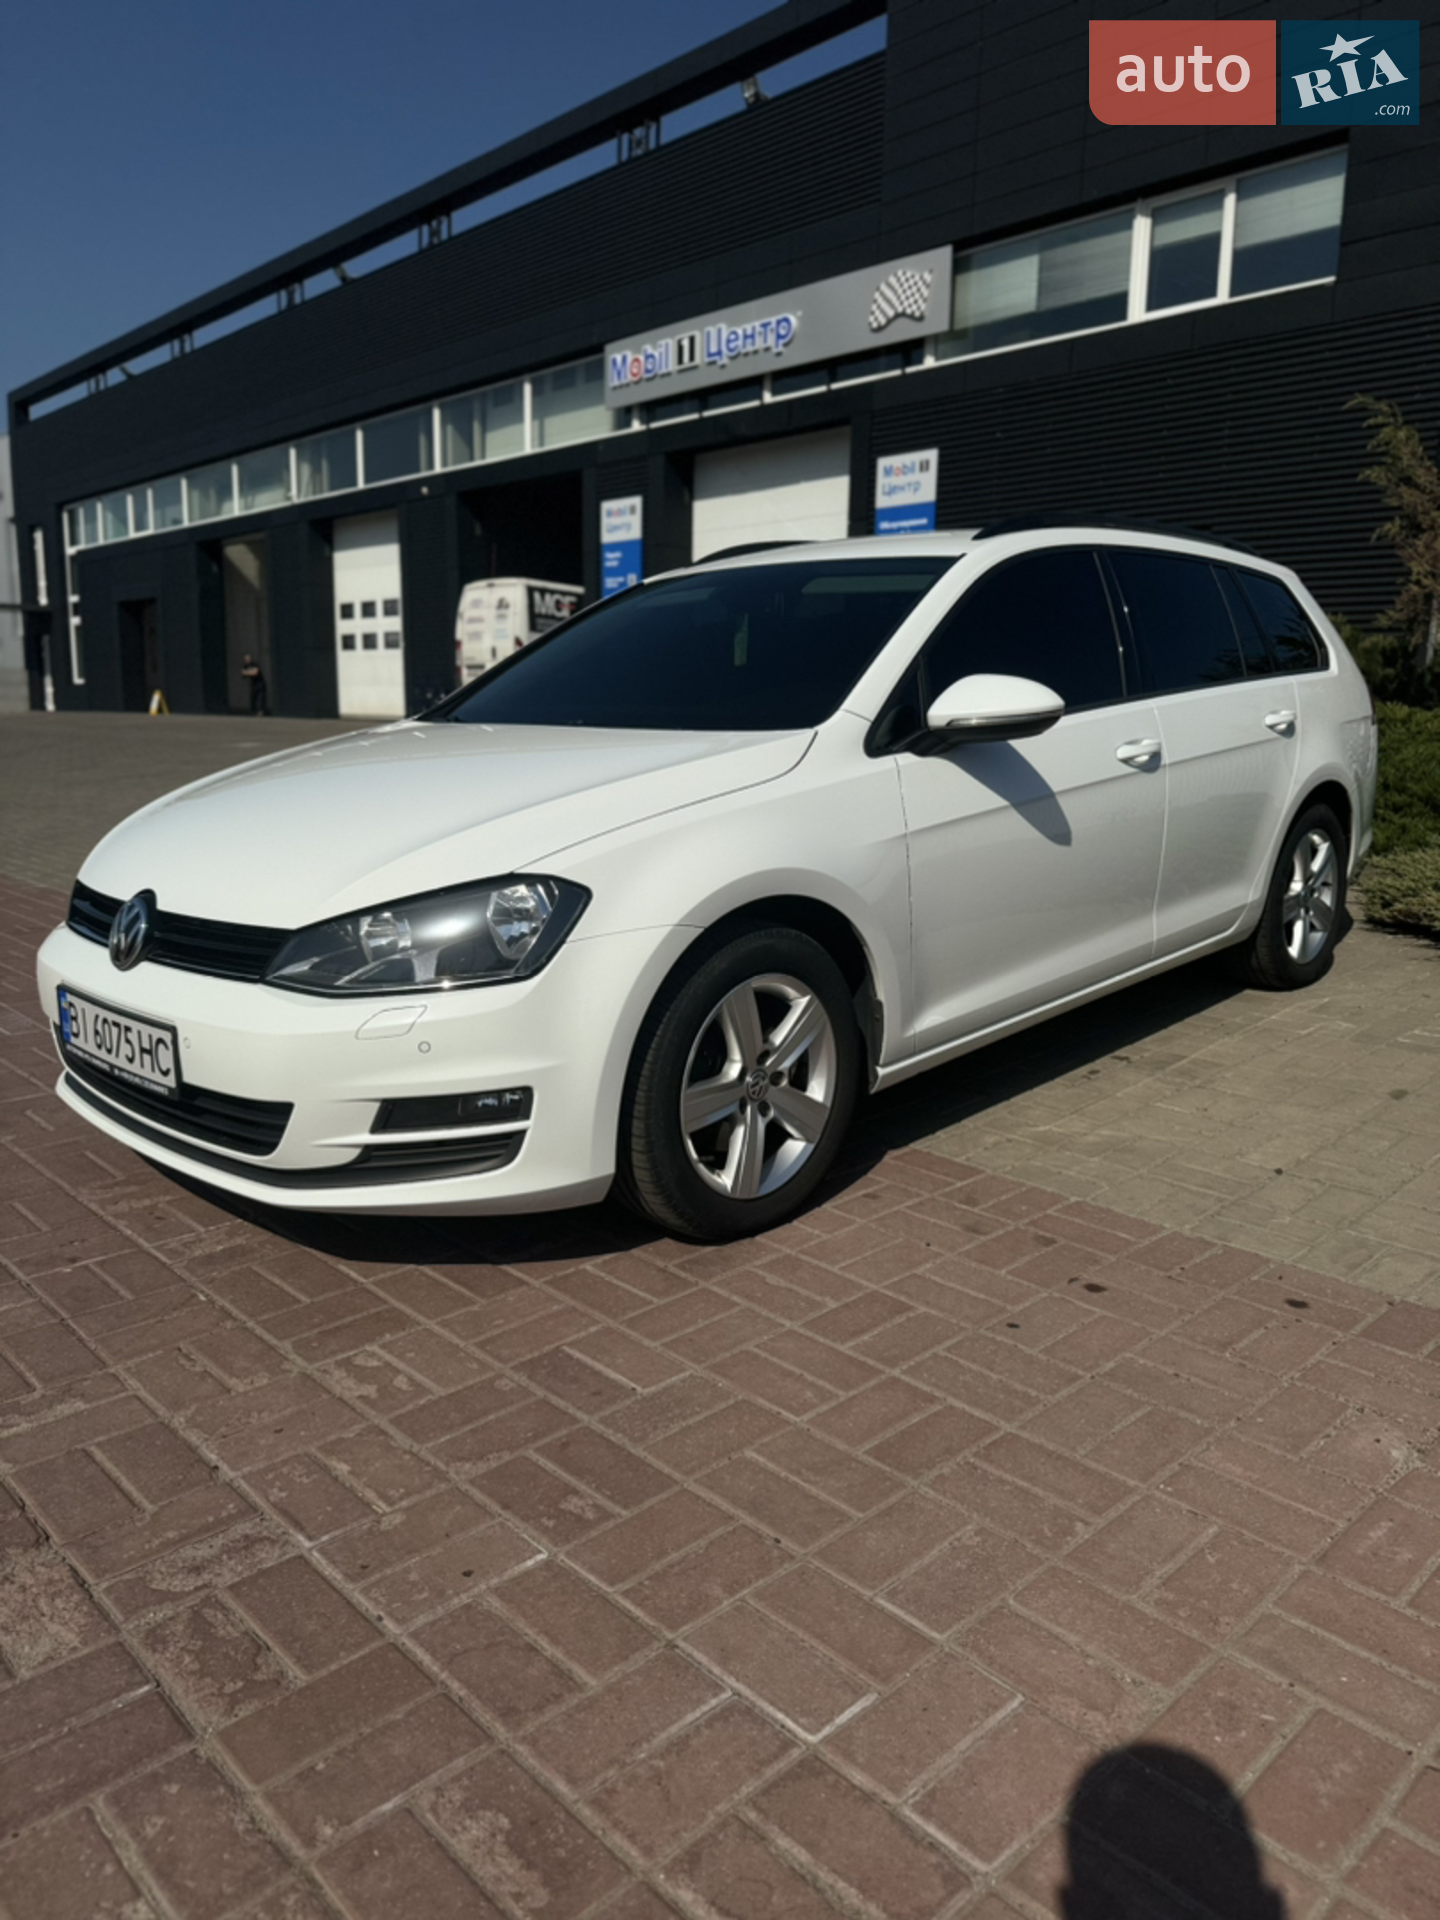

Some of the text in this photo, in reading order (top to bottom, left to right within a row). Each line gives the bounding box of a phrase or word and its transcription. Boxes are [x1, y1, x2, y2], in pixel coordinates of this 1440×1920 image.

[609, 313, 797, 387] Mobil 1 Центр
